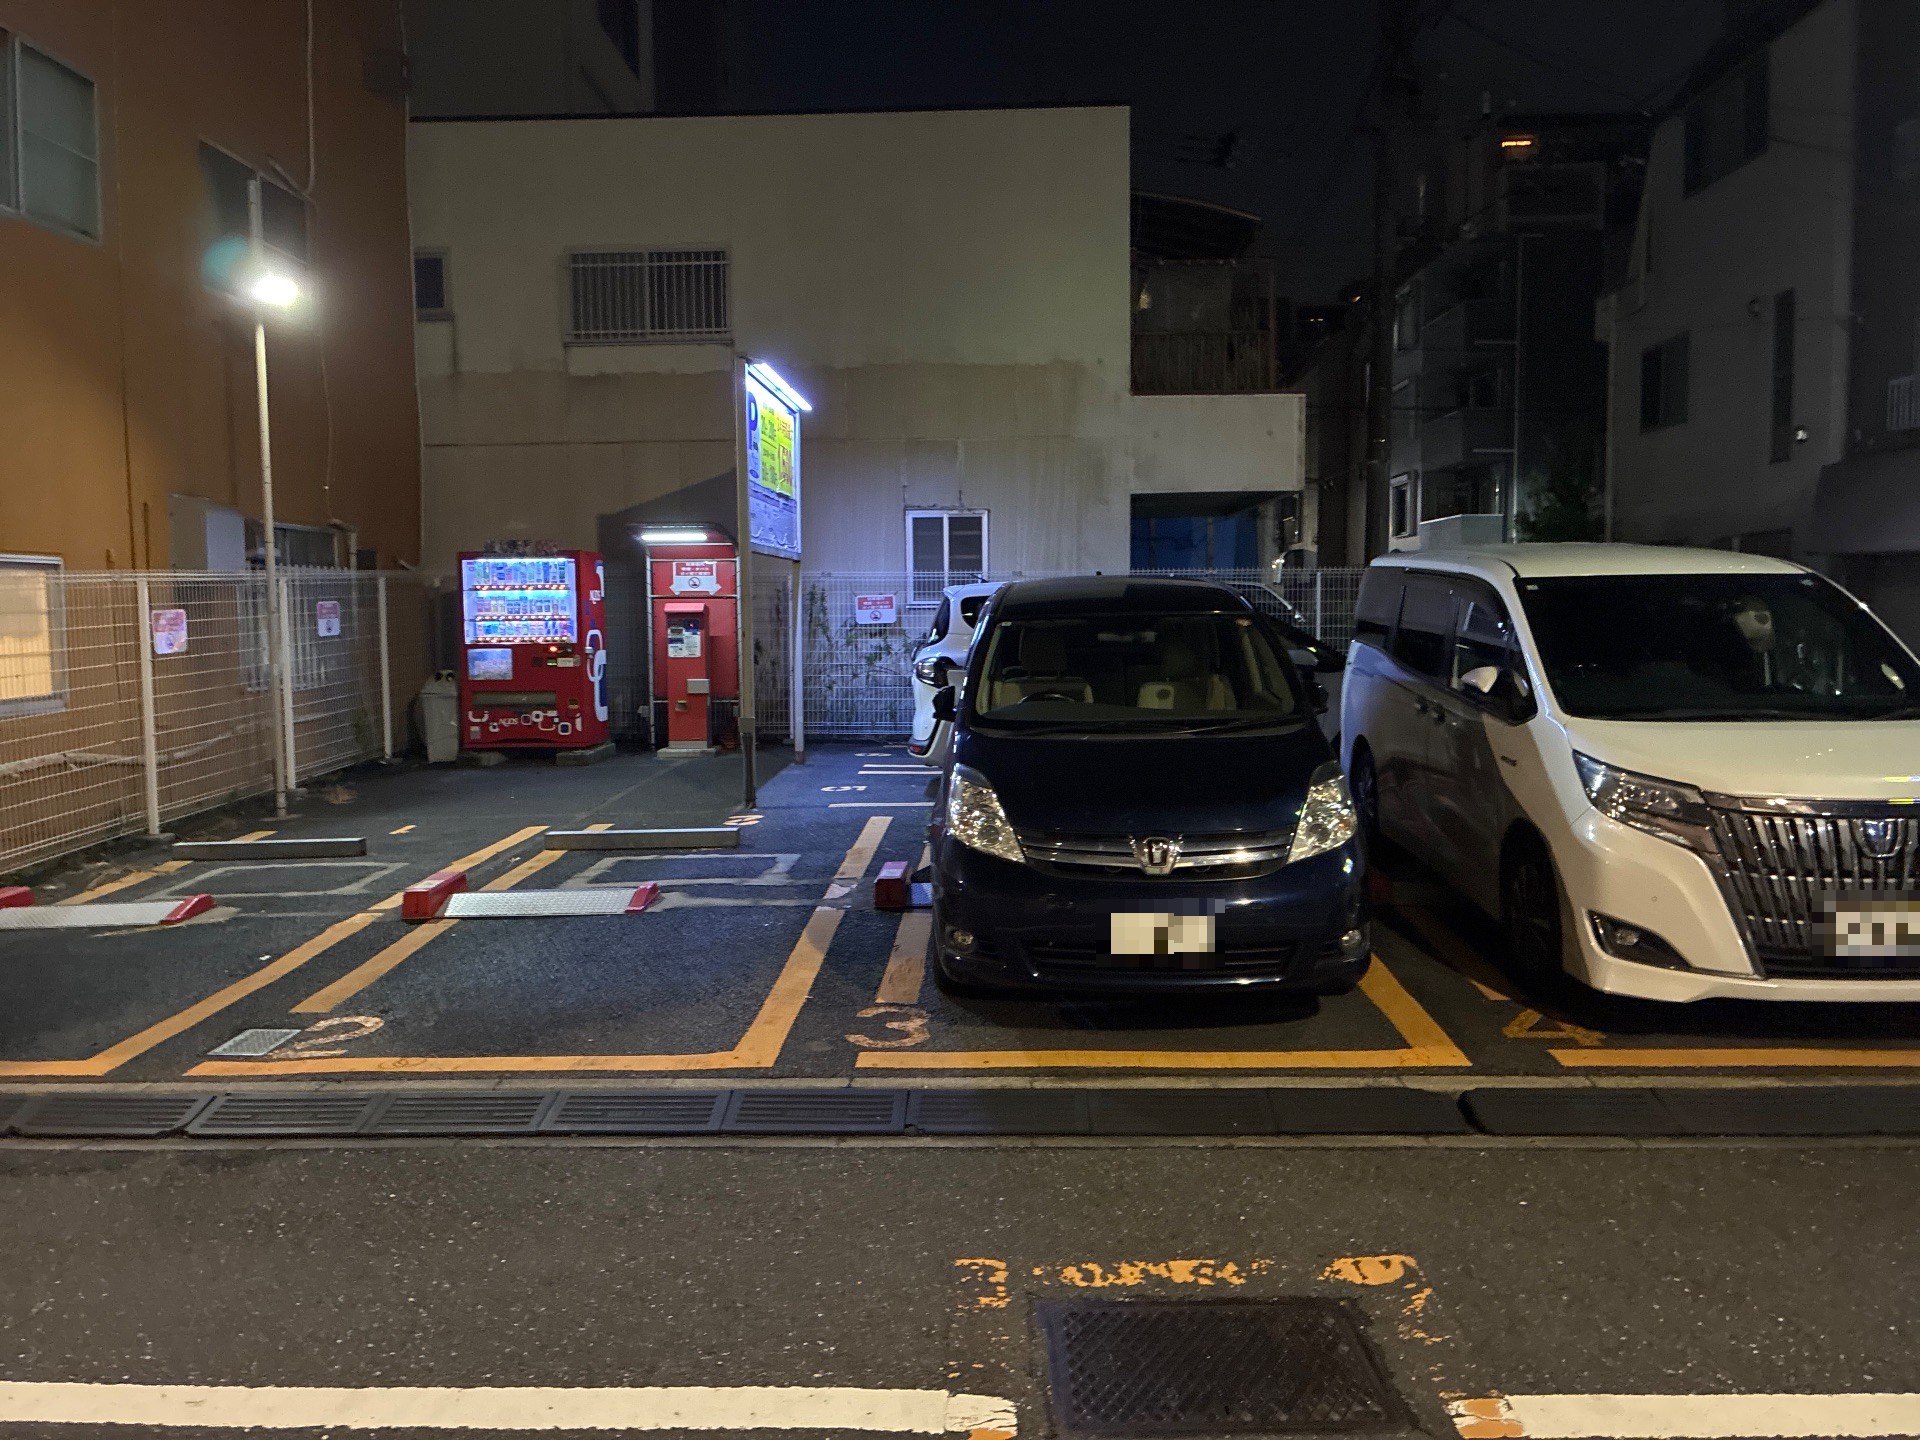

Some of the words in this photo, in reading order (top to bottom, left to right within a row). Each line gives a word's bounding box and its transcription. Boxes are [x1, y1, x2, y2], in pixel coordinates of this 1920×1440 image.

[747, 390, 758, 450] P
[267, 1014, 385, 1059] 2
[844, 1005, 931, 1048] 3
[1502, 1008, 1607, 1046] 4
